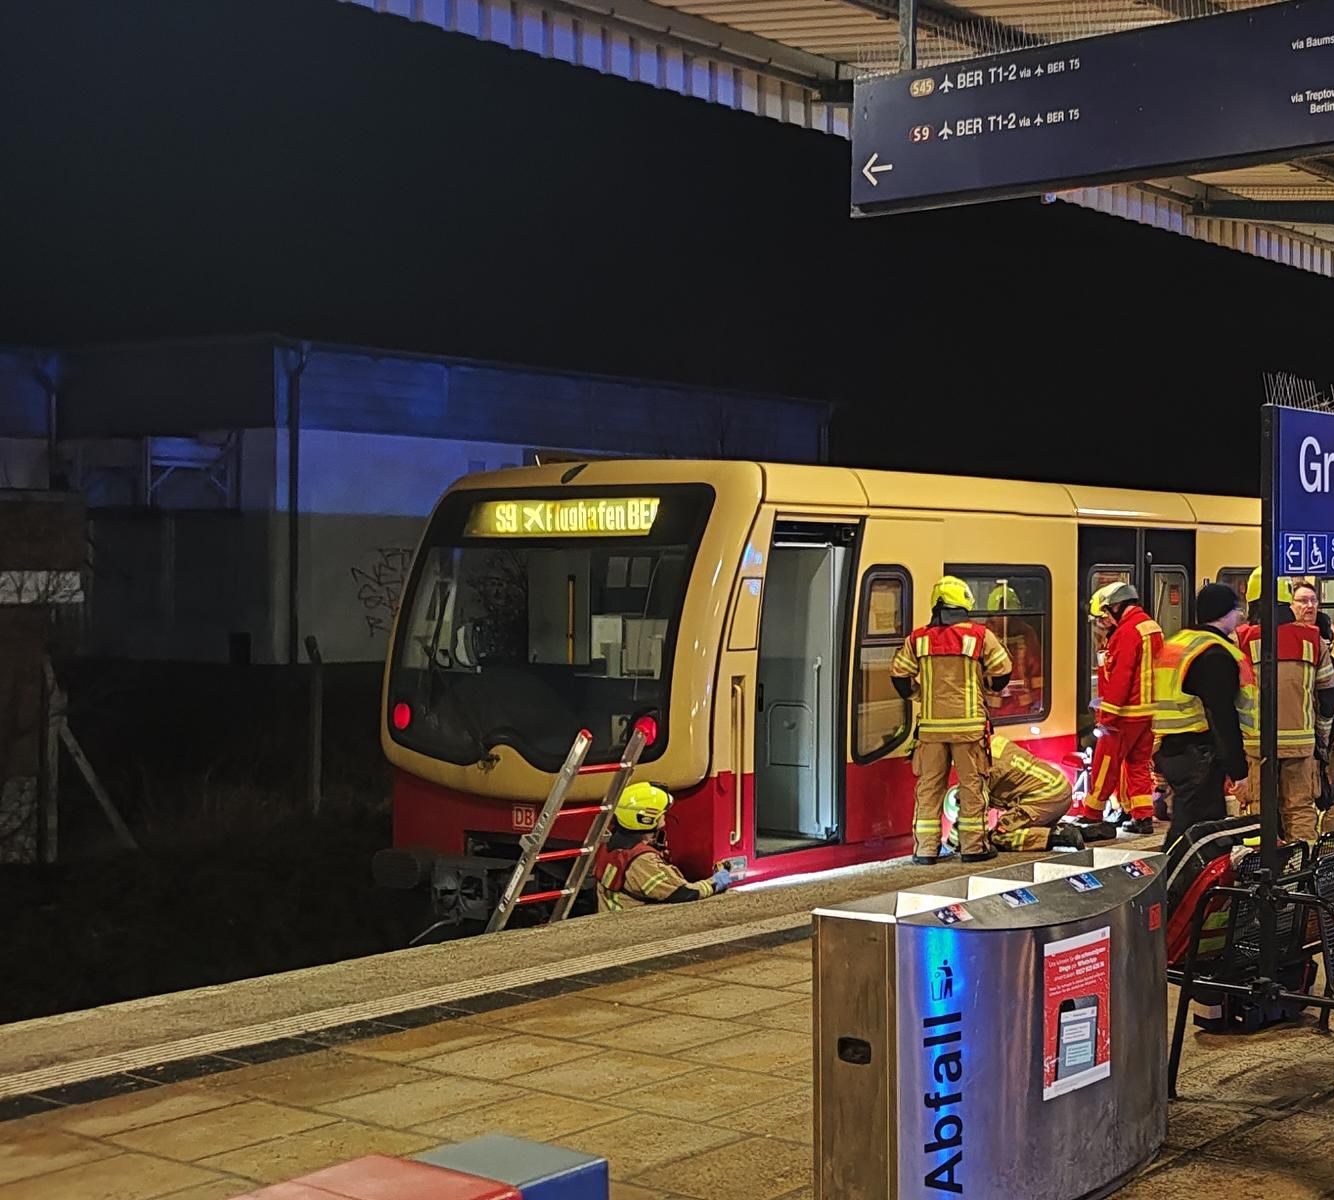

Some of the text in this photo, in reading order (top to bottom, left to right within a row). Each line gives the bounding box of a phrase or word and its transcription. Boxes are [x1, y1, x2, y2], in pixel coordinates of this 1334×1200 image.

[1292, 37, 1304, 50] via
[913, 58, 1080, 96] S45 BER T1-2 via BER T5
[1291, 93, 1303, 104] via
[1310, 101, 1334, 114] Berlin
[913, 108, 1080, 142] S9 BER T1-2 via BER T5
[495, 503, 517, 533] S9
[546, 501, 626, 532] Flughafen
[514, 809, 534, 827] DB
[923, 1012, 963, 1194] Abfall
